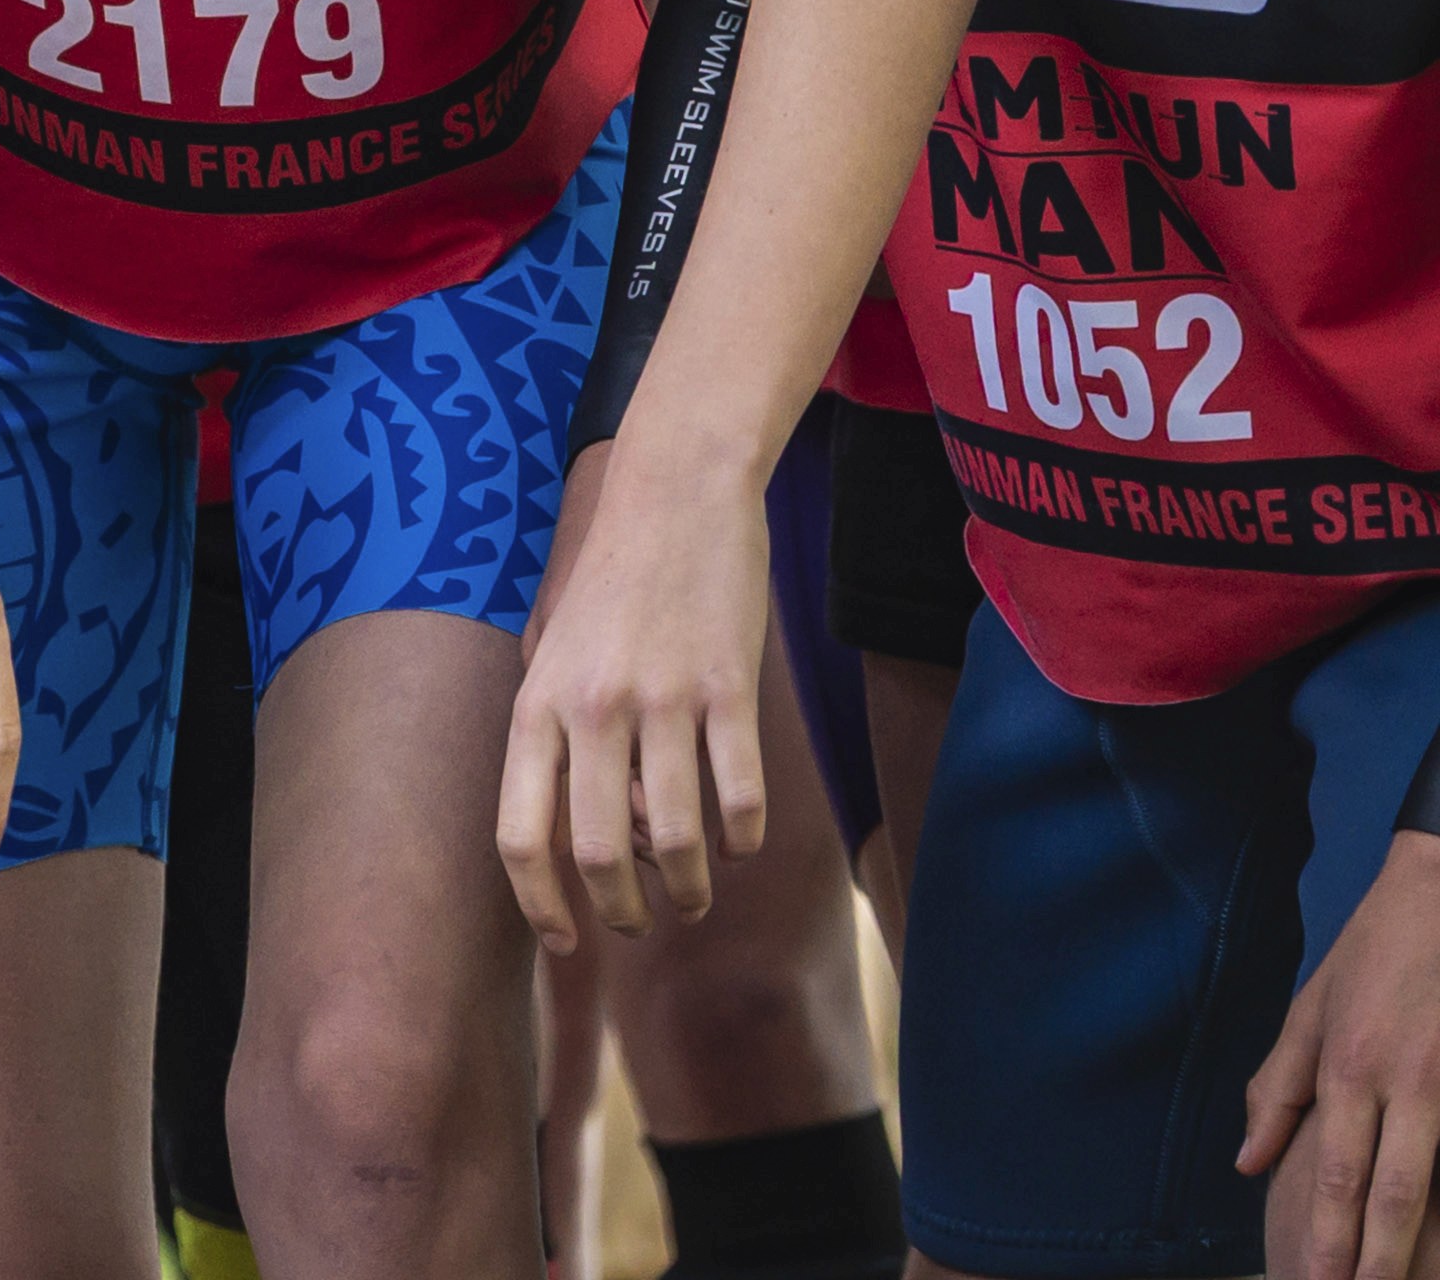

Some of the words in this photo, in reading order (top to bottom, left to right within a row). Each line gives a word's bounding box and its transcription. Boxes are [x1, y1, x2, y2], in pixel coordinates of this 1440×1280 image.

[186, 121, 422, 191] FRANCE
[443, 3, 556, 152] SERIES
[692, 10, 743, 96] SWIM
[640, 99, 711, 254] SLEEVES
[927, 128, 1228, 275] MAN
[626, 259, 657, 300] 1.5
[948, 271, 1253, 442] 1052
[1093, 478, 1293, 546] FRANCE
